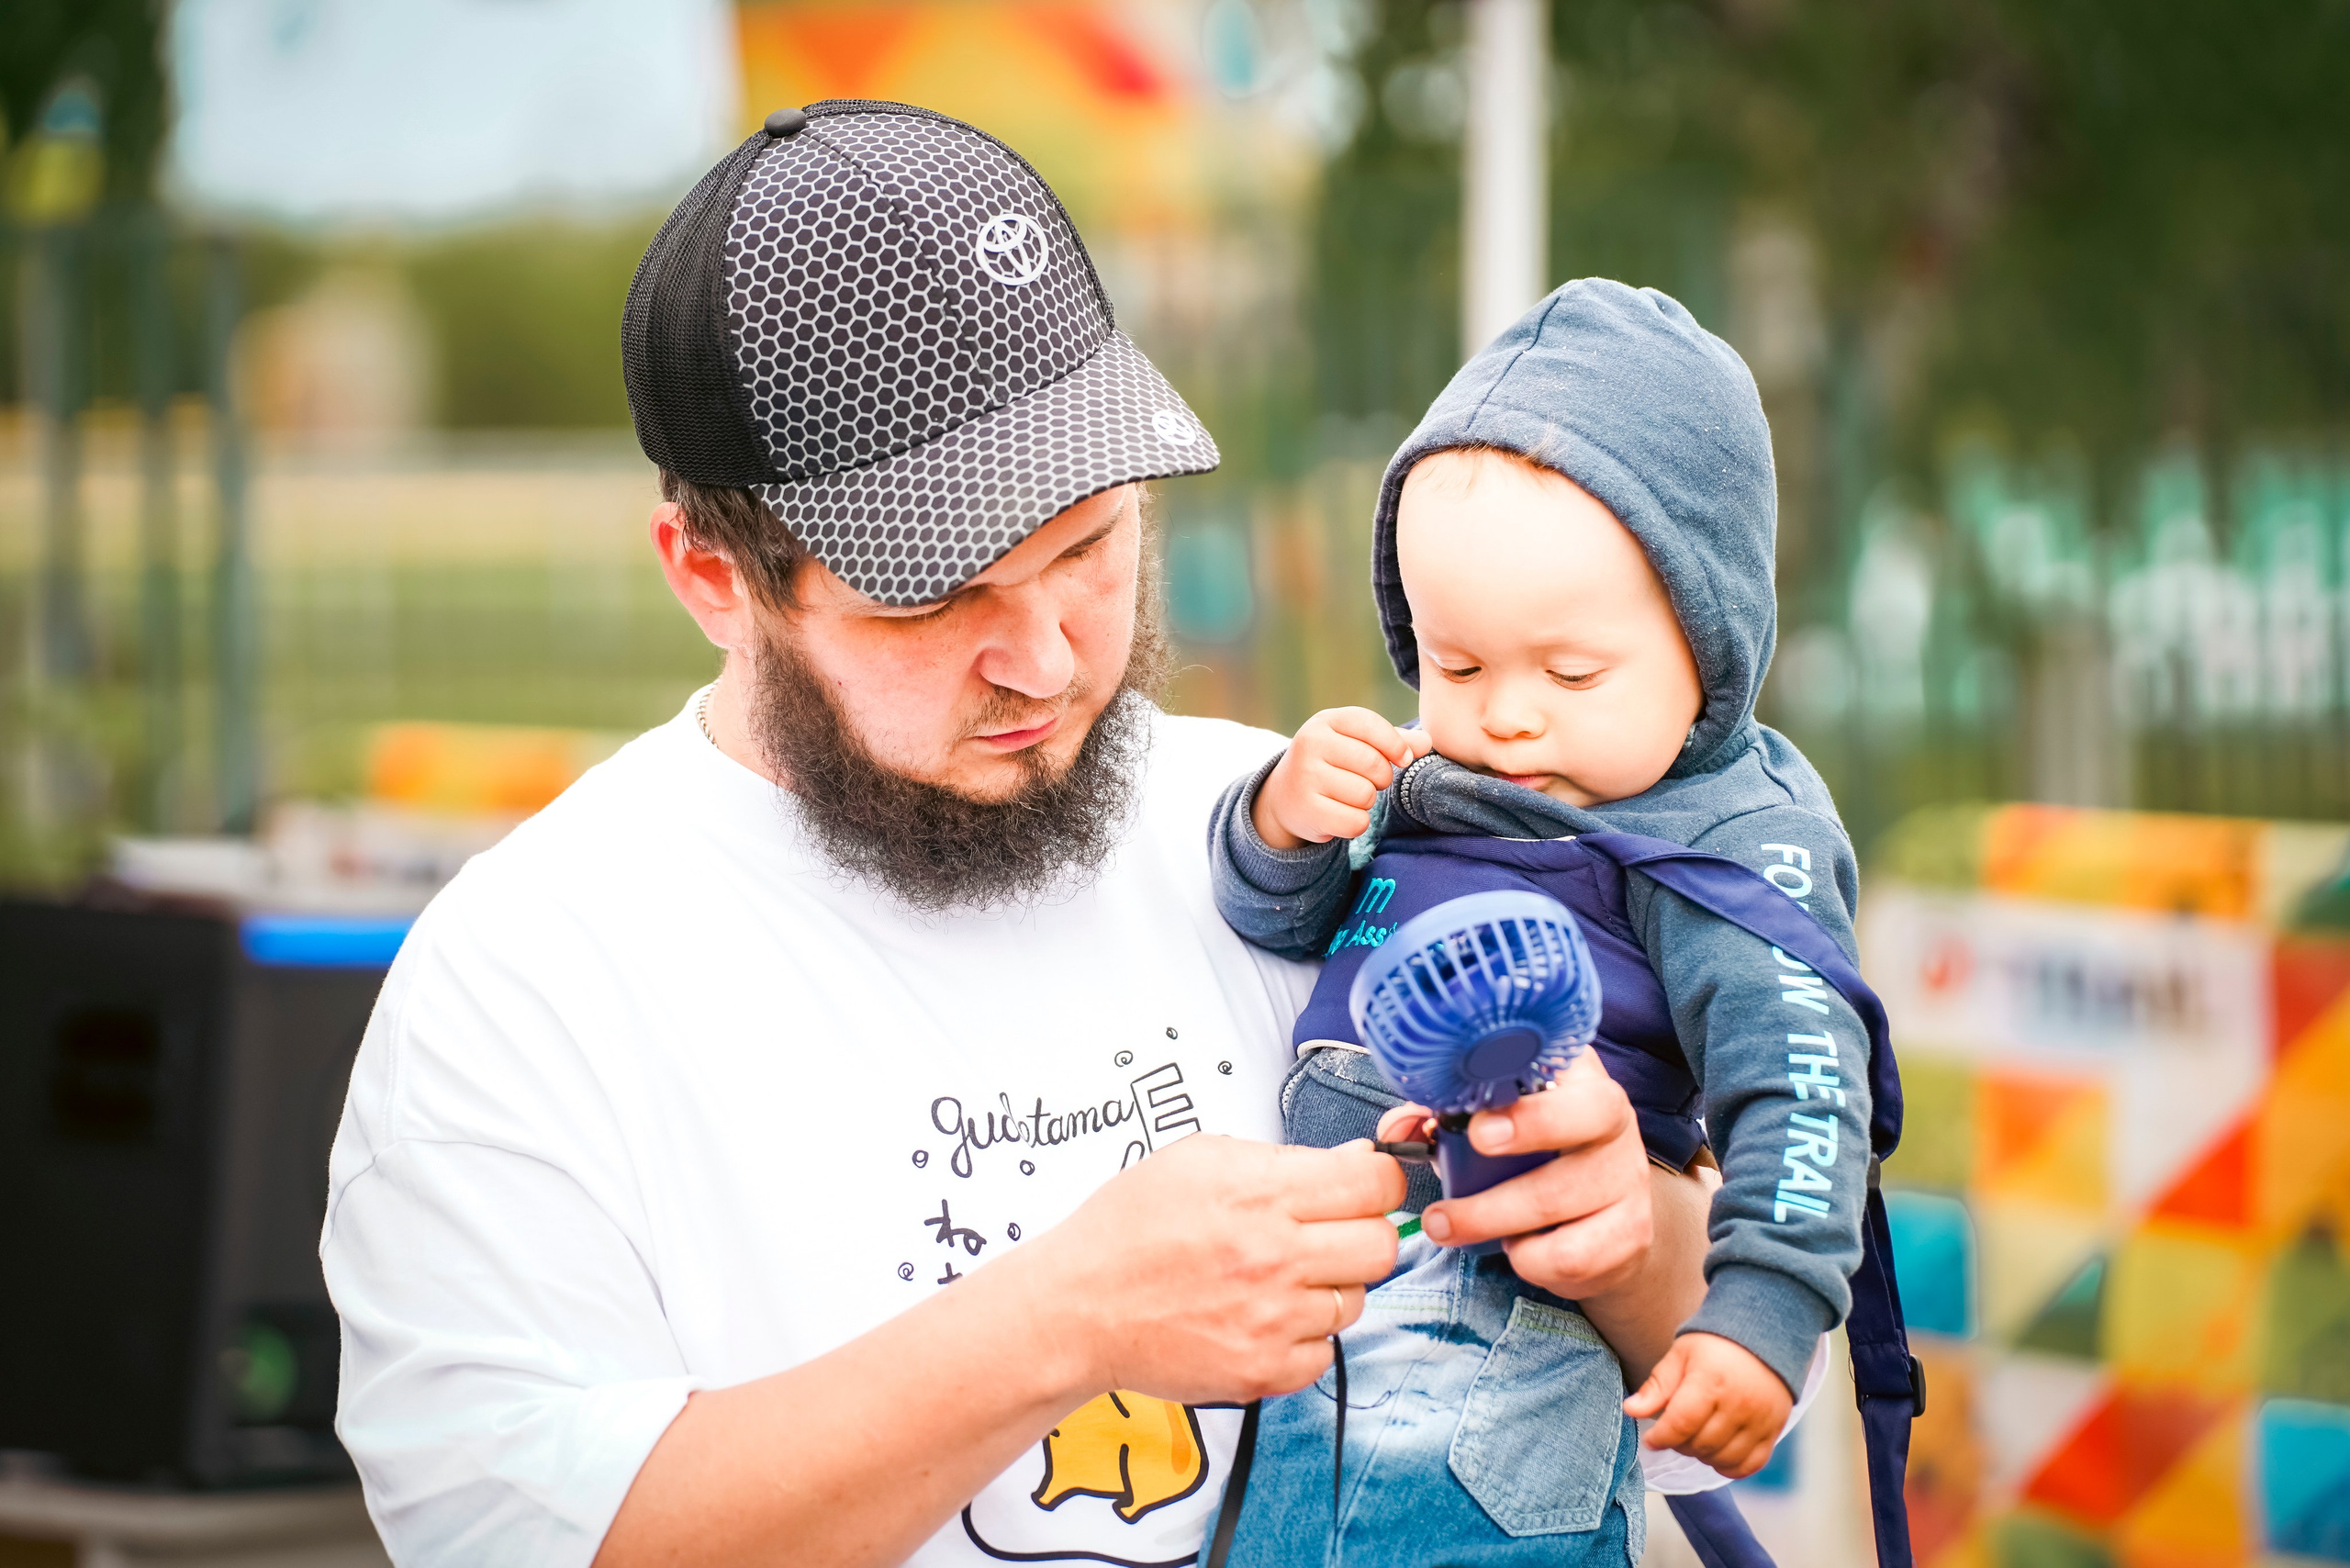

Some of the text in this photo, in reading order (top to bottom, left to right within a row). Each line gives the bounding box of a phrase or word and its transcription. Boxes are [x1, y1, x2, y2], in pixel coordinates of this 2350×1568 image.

[1344, 919, 1398, 948] Ass
[1787, 1029, 1847, 1108] THE
[1774, 1112, 1840, 1224] TRAIL
